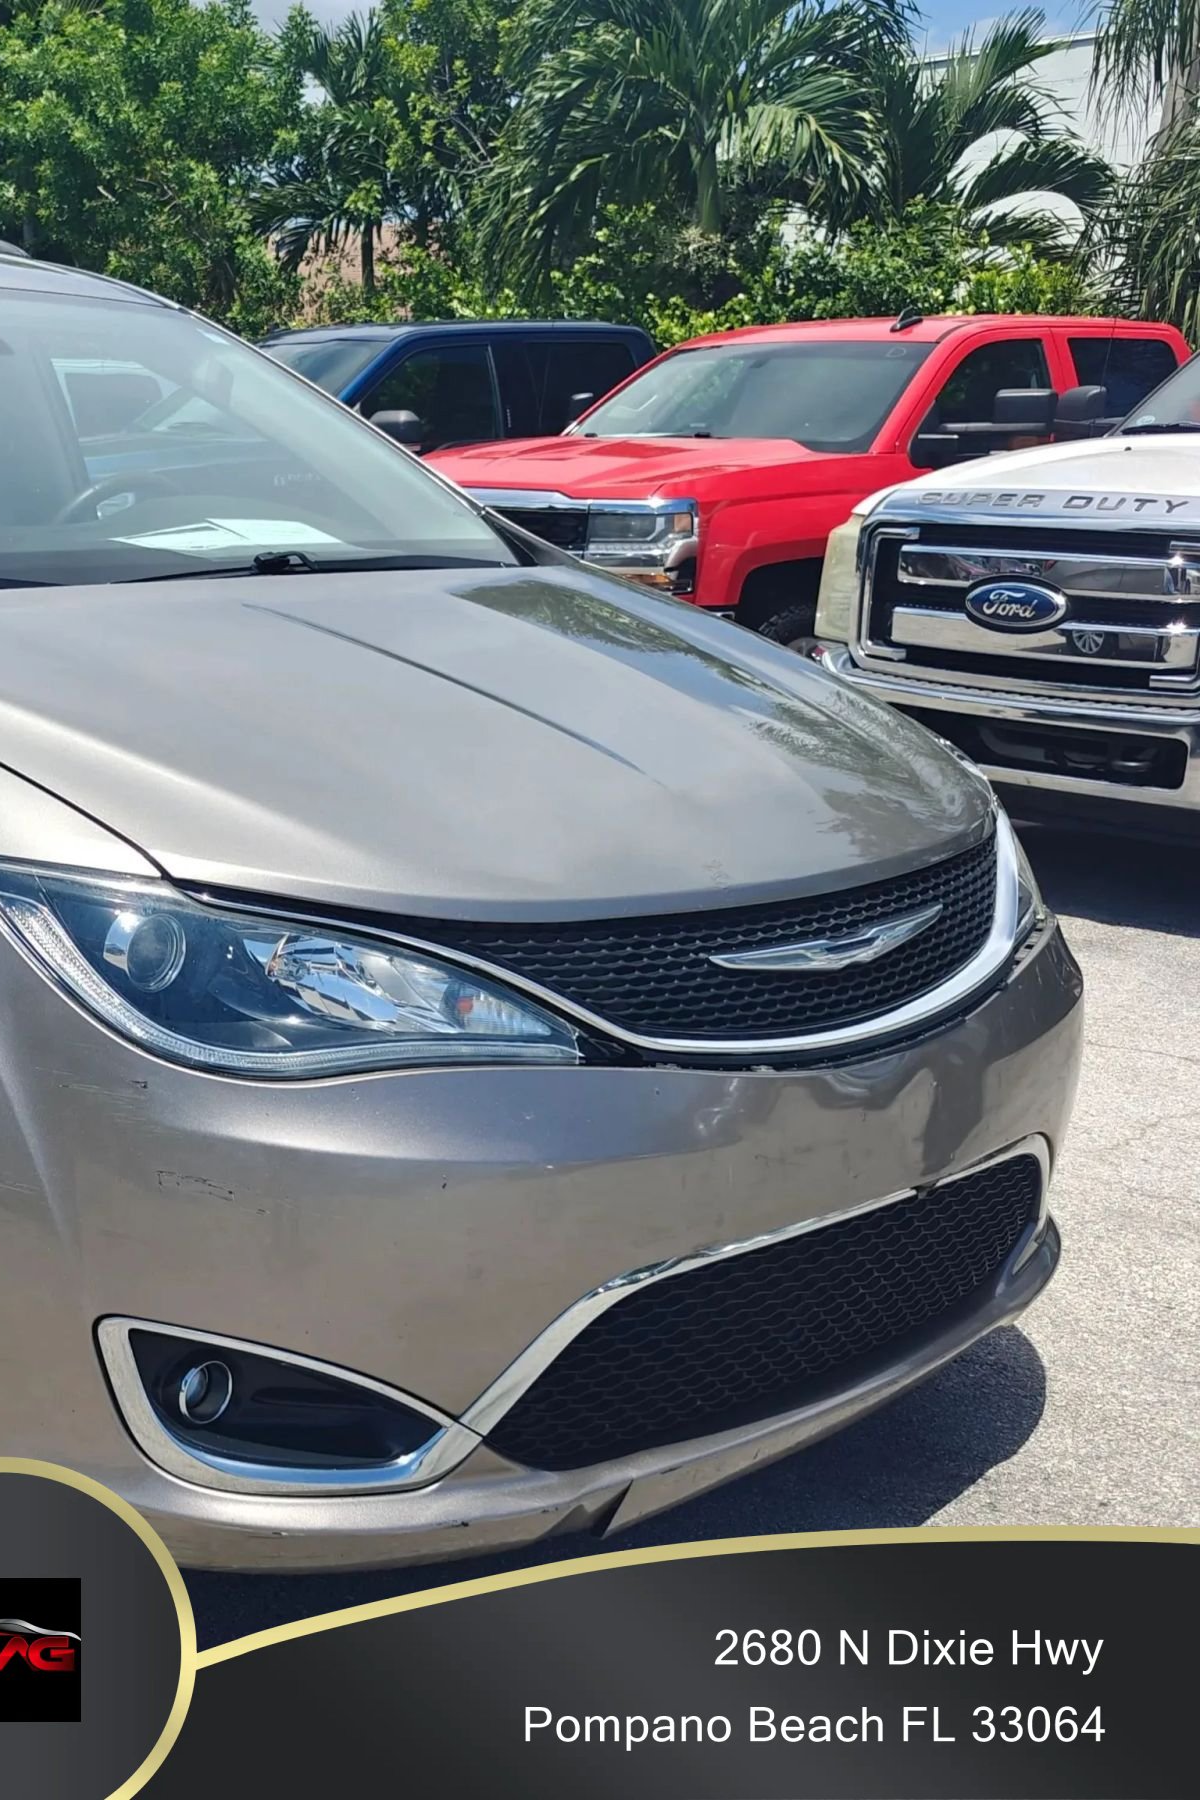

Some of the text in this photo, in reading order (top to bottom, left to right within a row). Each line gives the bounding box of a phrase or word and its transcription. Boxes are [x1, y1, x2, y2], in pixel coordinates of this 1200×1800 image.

[915, 491, 1189, 514] SUPER DUTY
[982, 588, 1036, 619] Ford
